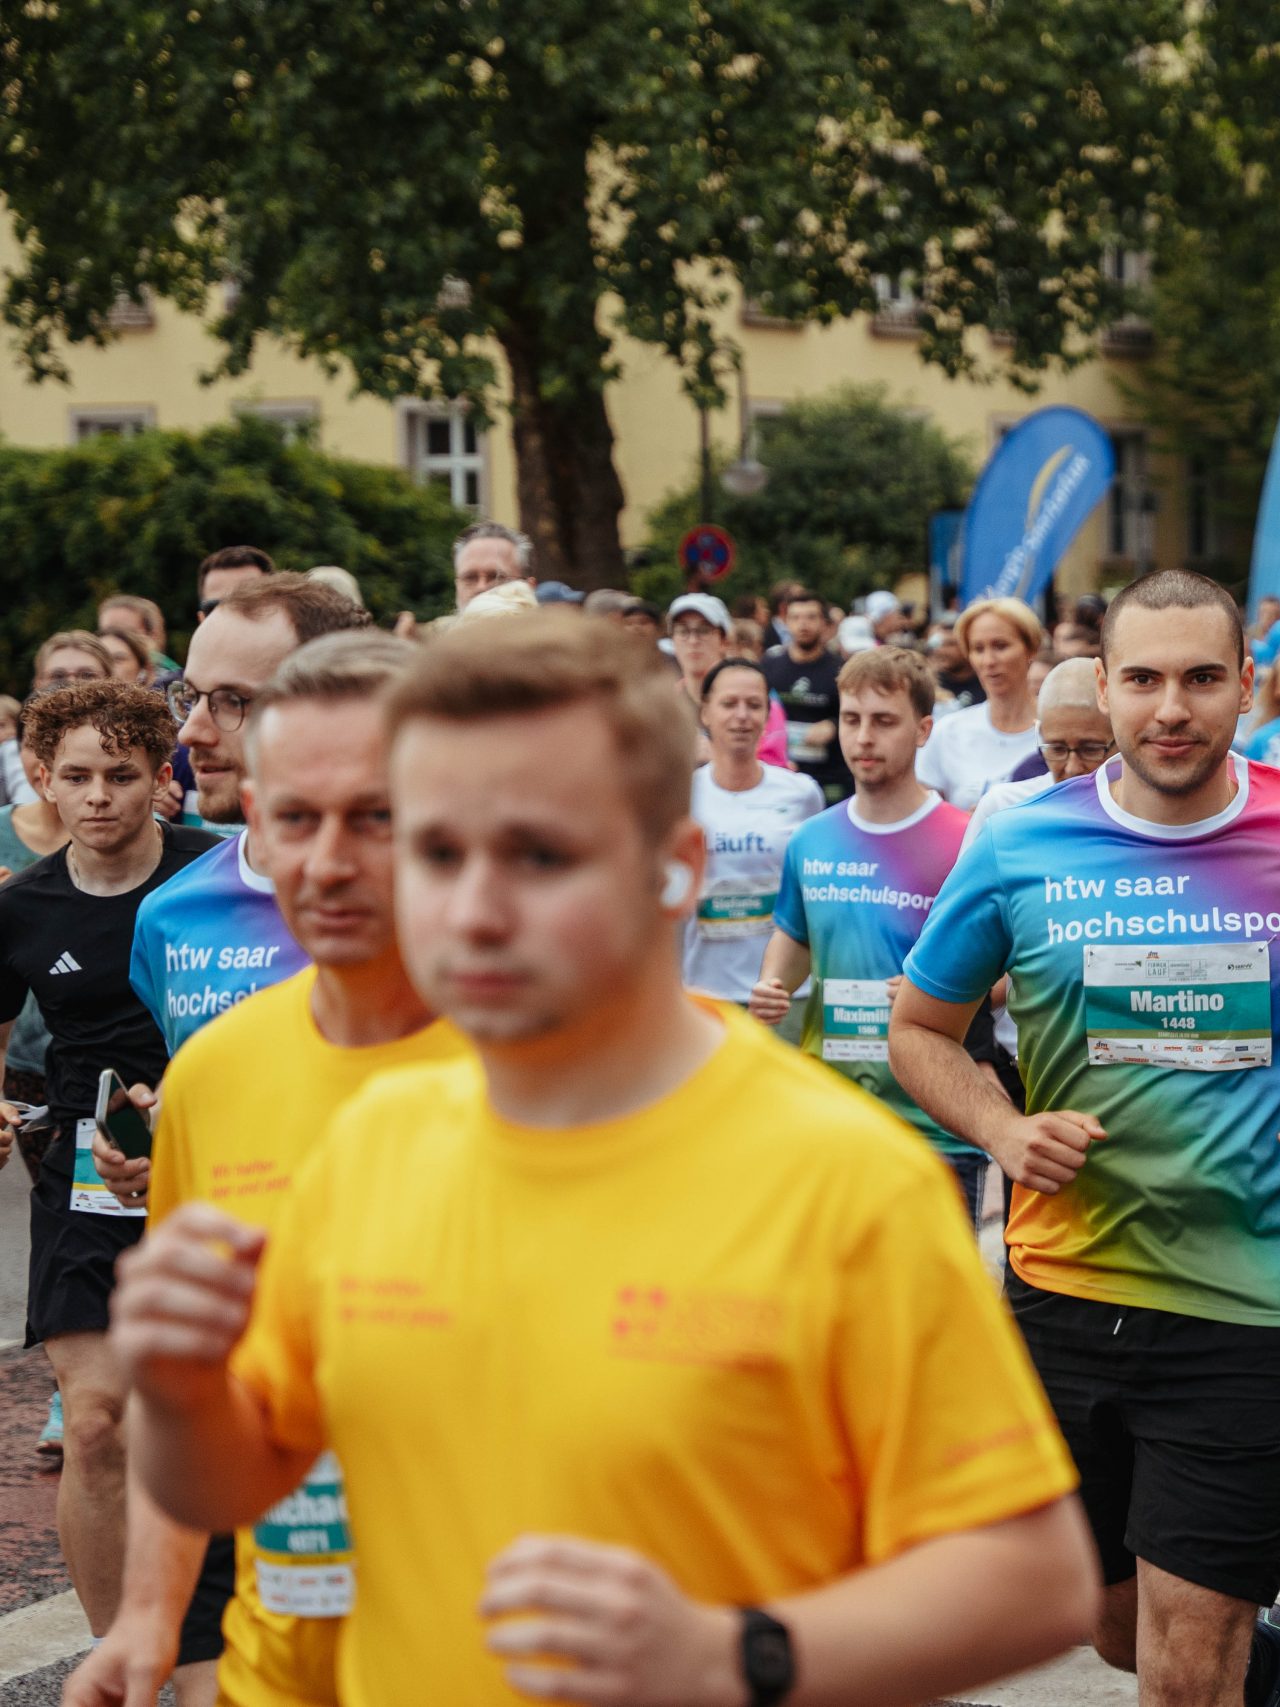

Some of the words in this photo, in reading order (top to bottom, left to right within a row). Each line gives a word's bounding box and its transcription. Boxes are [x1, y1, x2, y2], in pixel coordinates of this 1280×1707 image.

[803, 857, 833, 877] htw
[836, 861, 879, 877] saar
[803, 882, 936, 911] hochschulspor
[1044, 876, 1105, 903] htw
[1114, 875, 1190, 898] saar
[165, 943, 213, 973] htw
[217, 945, 280, 970] saar
[1147, 968, 1167, 977] LAUF
[1130, 990, 1224, 1012] Martino
[833, 1007, 889, 1024] Maximili
[1161, 1017, 1196, 1029] 1448
